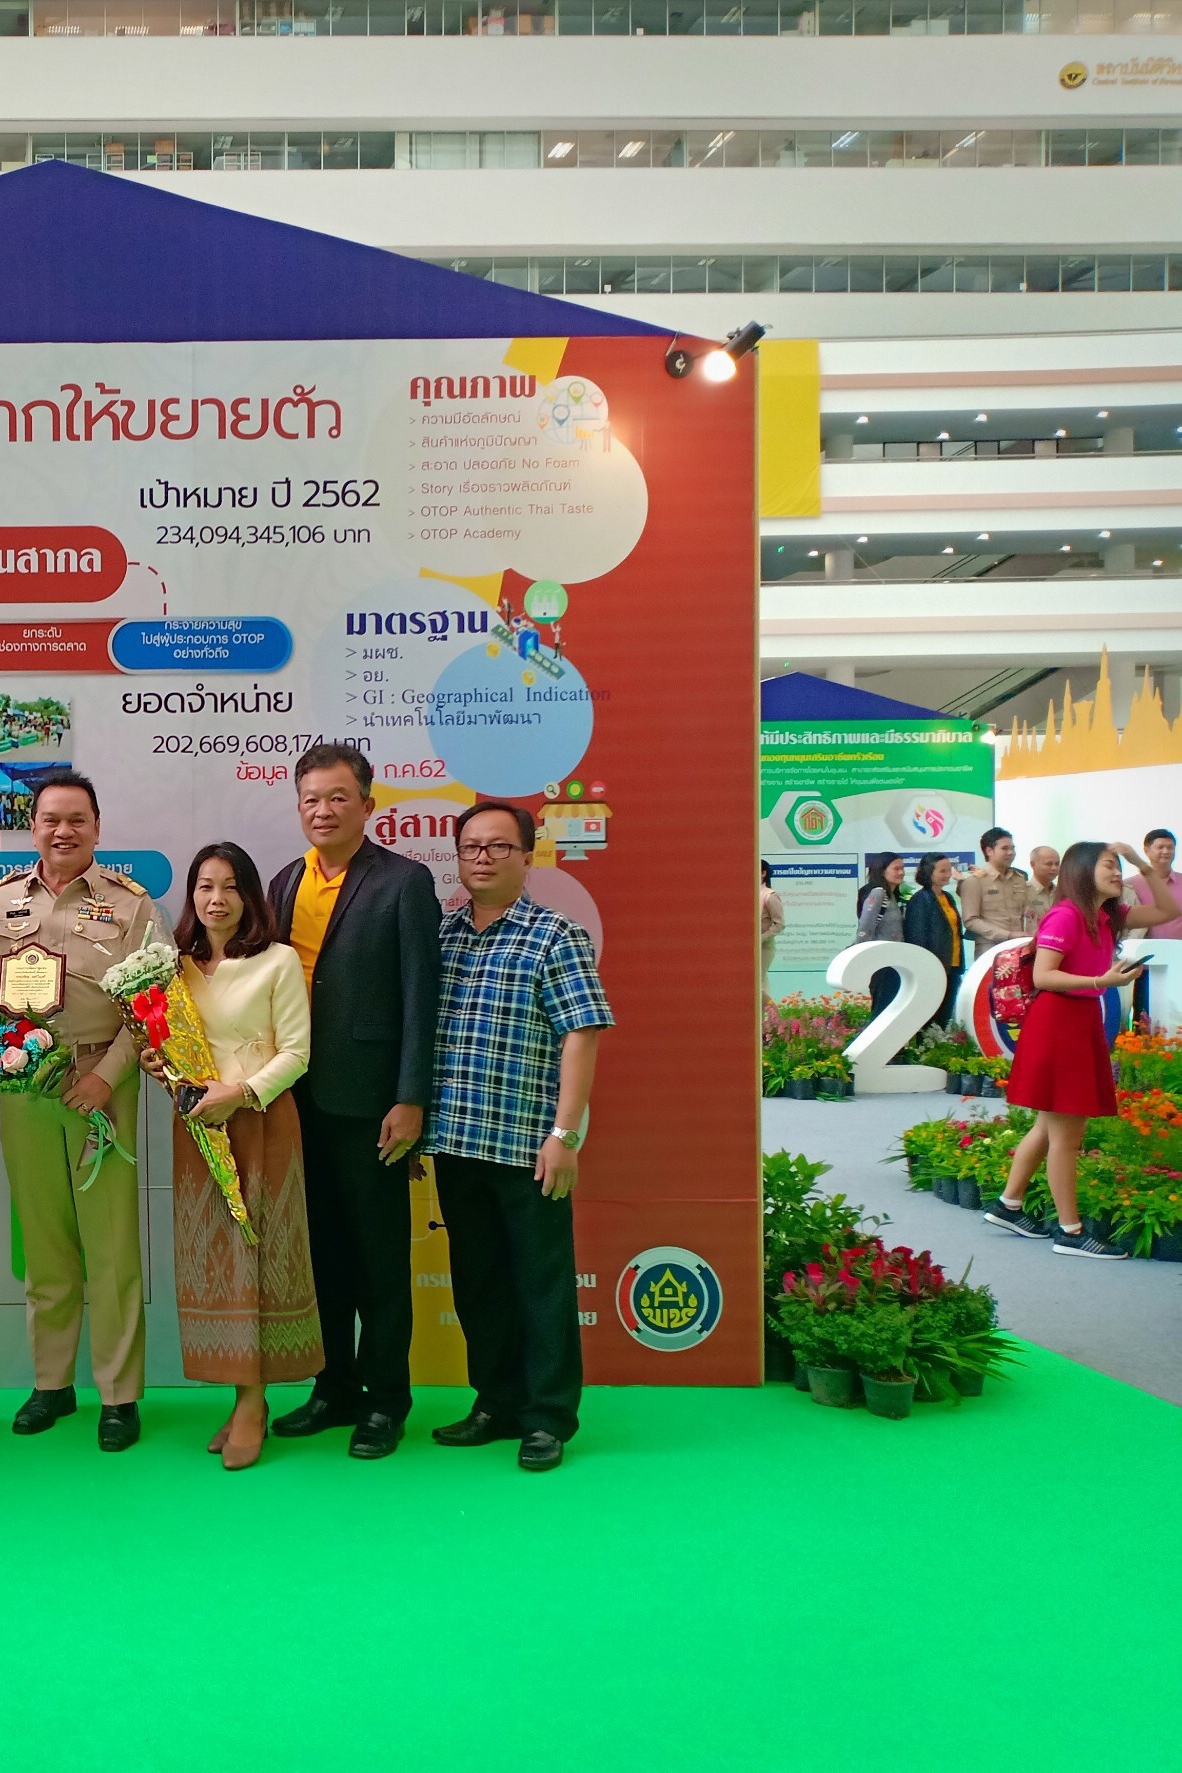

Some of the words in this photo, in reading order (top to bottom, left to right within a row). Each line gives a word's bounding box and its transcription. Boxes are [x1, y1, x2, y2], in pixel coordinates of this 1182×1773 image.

[410, 374, 537, 407] คุณภาพ
[421, 460, 458, 471] สะอาด
[463, 457, 516, 470] ปลอดภัย
[522, 458, 540, 470] No
[546, 457, 580, 469] Foam
[139, 479, 258, 509] เป้าหมาย
[271, 477, 292, 508] ปี
[302, 479, 382, 508] 2562
[421, 482, 454, 496] Story
[420, 505, 458, 517] OTOP
[463, 504, 522, 517] Authentic
[528, 503, 554, 516] Thai
[560, 502, 594, 515] Taste
[156, 525, 326, 548] 234,094,345,106
[334, 528, 372, 545] บาท
[420, 528, 458, 540] OTOP
[463, 527, 522, 541] Academy
[22, 626, 63, 639] ยกระดับ
[346, 609, 489, 642] มาตรฐาน
[232, 633, 265, 645] OTOP
[173, 646, 230, 659] อย่างทั่วถึง
[362, 646, 404, 660] มผช.
[363, 669, 389, 683] อย.
[122, 683, 293, 715] ยอดจำหน่าย
[363, 689, 385, 705] GI
[401, 686, 513, 708] Geographical
[526, 685, 611, 702] Indication
[362, 705, 542, 728] นำเทคโนโลยีมาพัฒนา
[152, 734, 324, 758] 202,669,608,174
[236, 760, 288, 787] ข้อมูล
[383, 759, 447, 779] ก.ค.62
